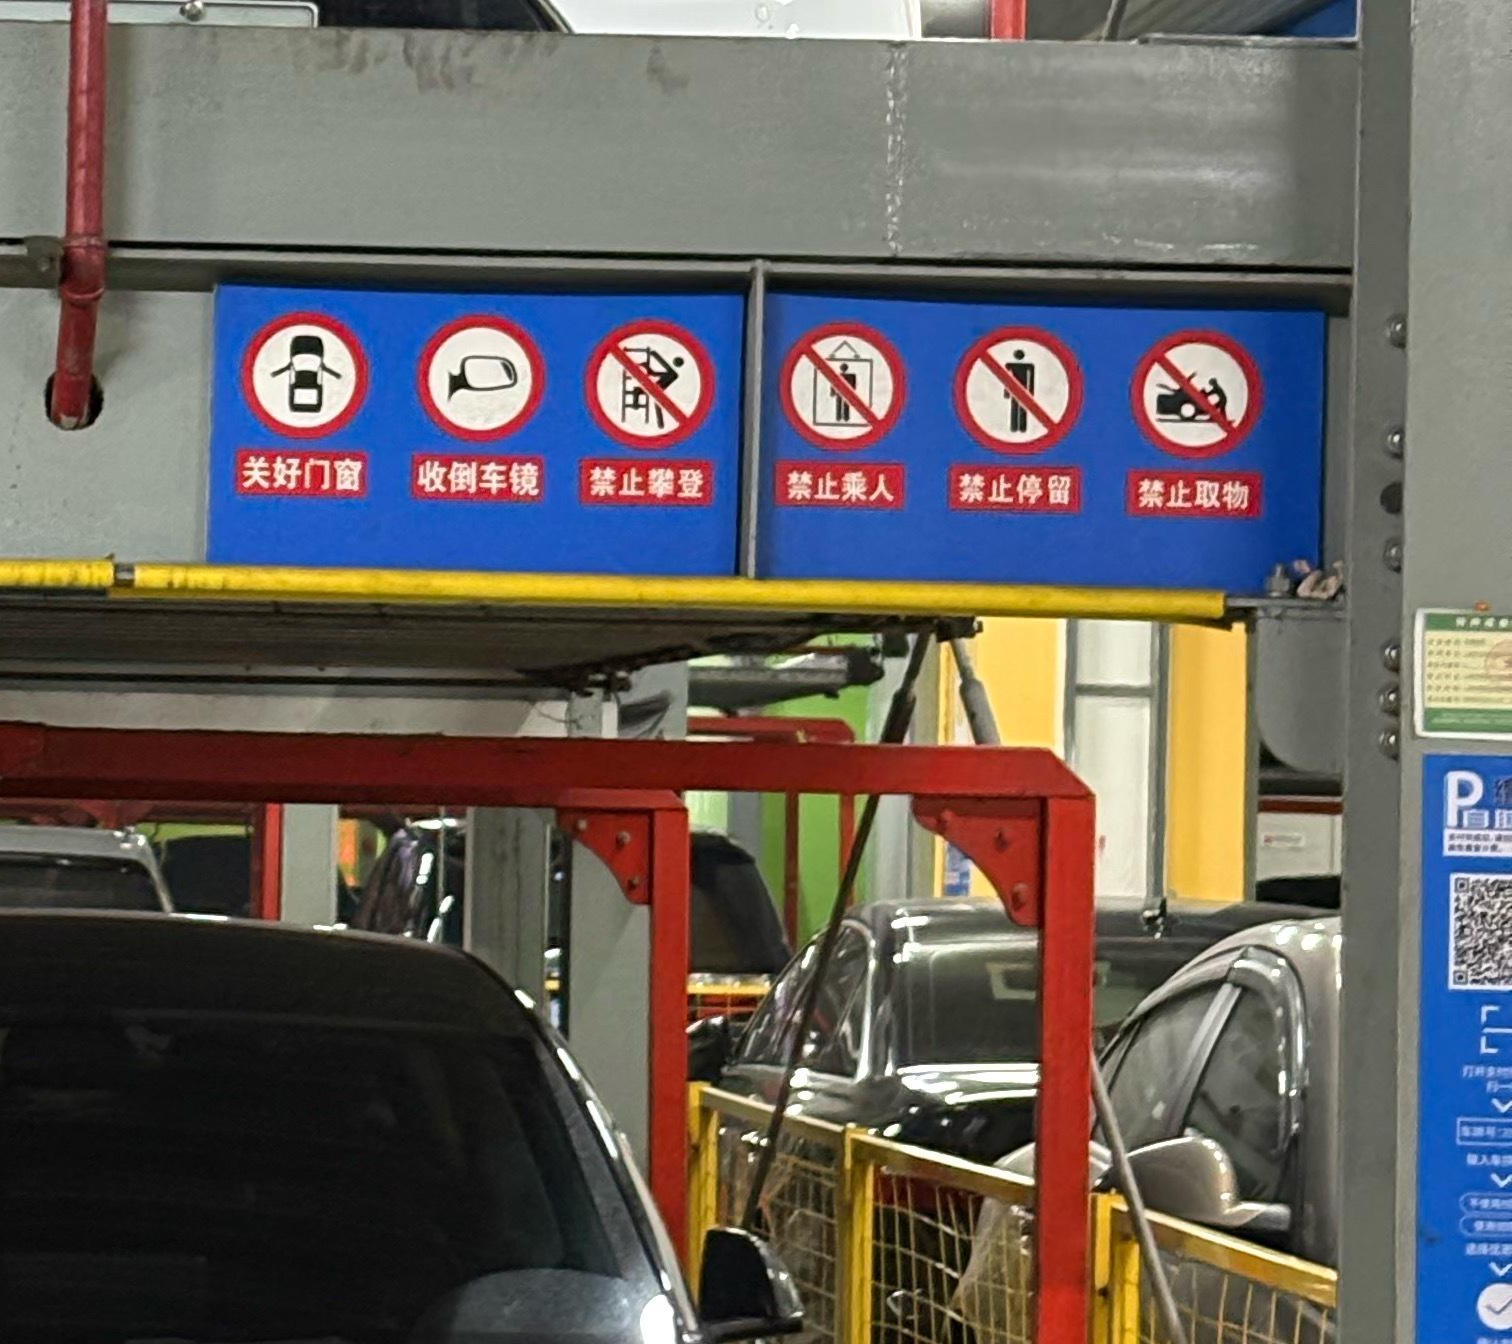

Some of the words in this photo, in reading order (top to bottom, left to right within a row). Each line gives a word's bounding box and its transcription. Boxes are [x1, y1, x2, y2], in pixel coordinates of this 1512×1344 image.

[241, 456, 363, 492] 关好门窗
[417, 460, 541, 497] 收倒车镜
[589, 465, 705, 500] 禁止攀登
[786, 470, 896, 504] 禁止乘人
[958, 472, 1073, 507] 禁止停留
[1137, 477, 1250, 512] 禁止取物
